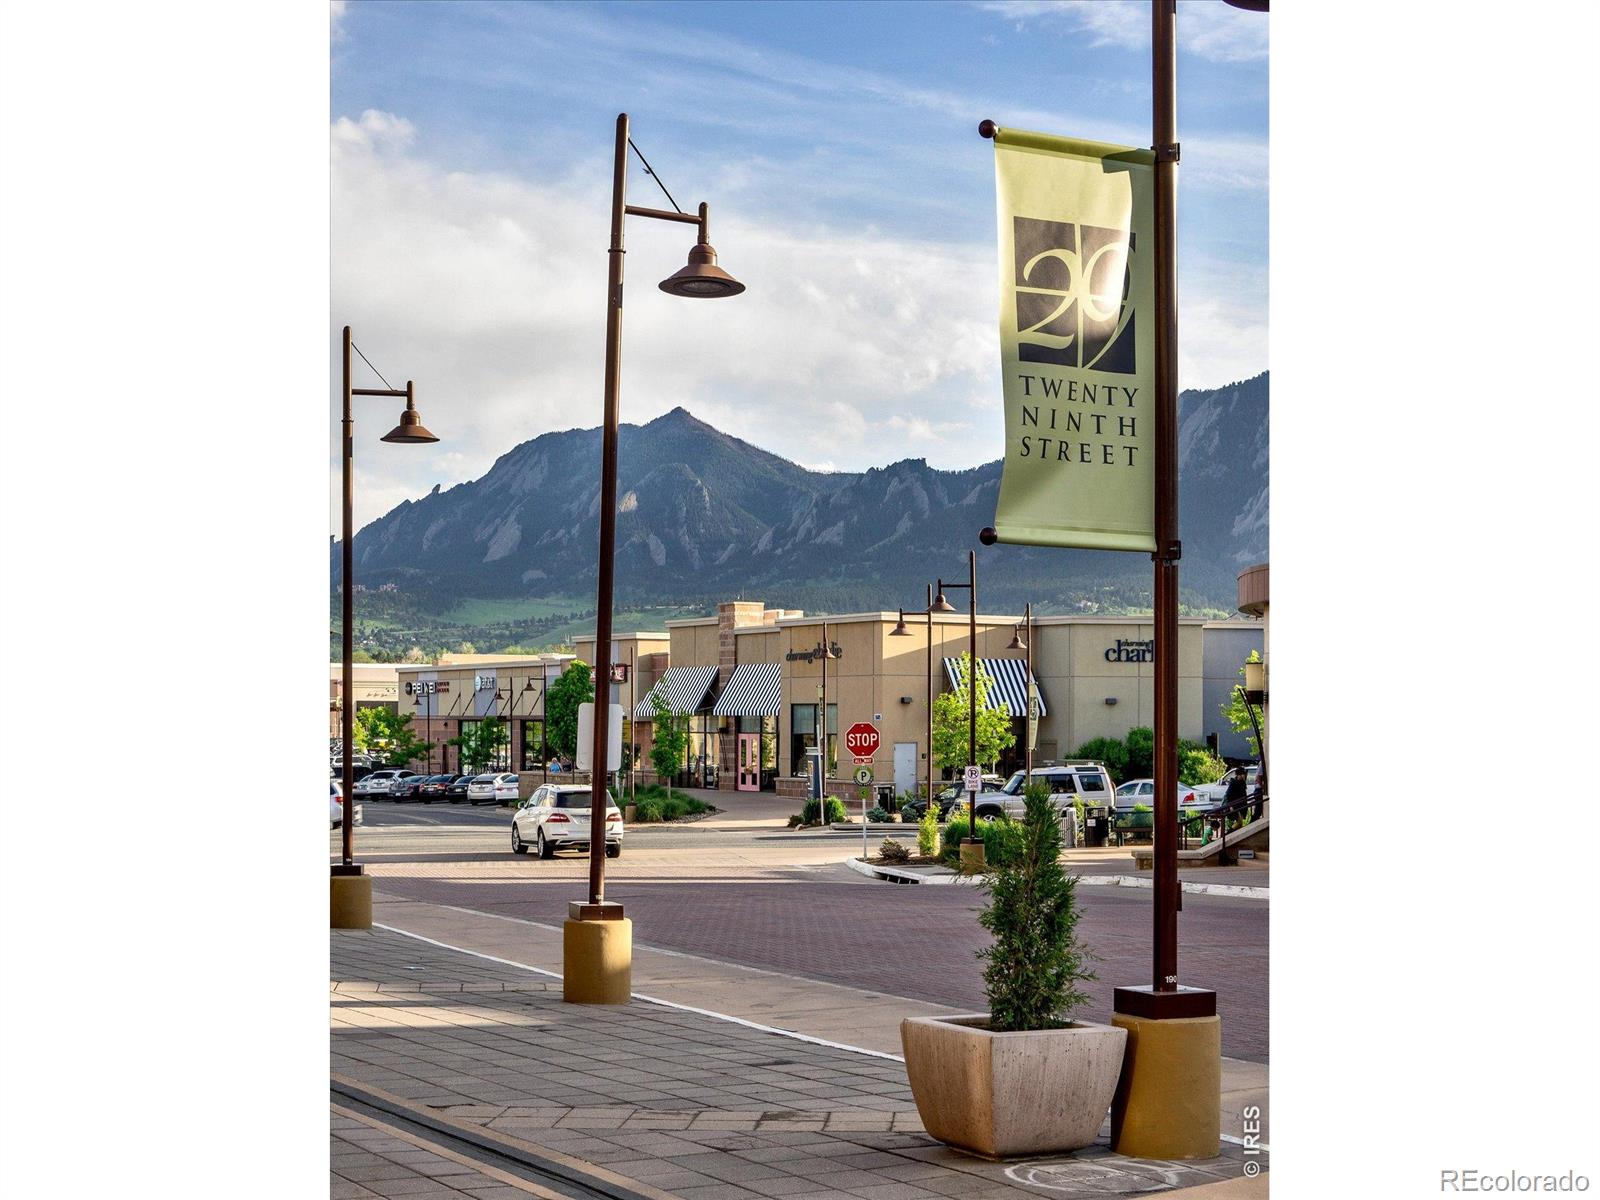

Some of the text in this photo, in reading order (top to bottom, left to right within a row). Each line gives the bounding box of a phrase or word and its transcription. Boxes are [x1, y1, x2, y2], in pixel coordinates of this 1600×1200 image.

[1018, 375, 1139, 408] TWENTY
[1020, 405, 1137, 438] NINTH
[1020, 435, 1139, 467] STREET
[813, 641, 842, 659] chlie
[1104, 639, 1154, 663] charl
[848, 733, 878, 747] STOP
